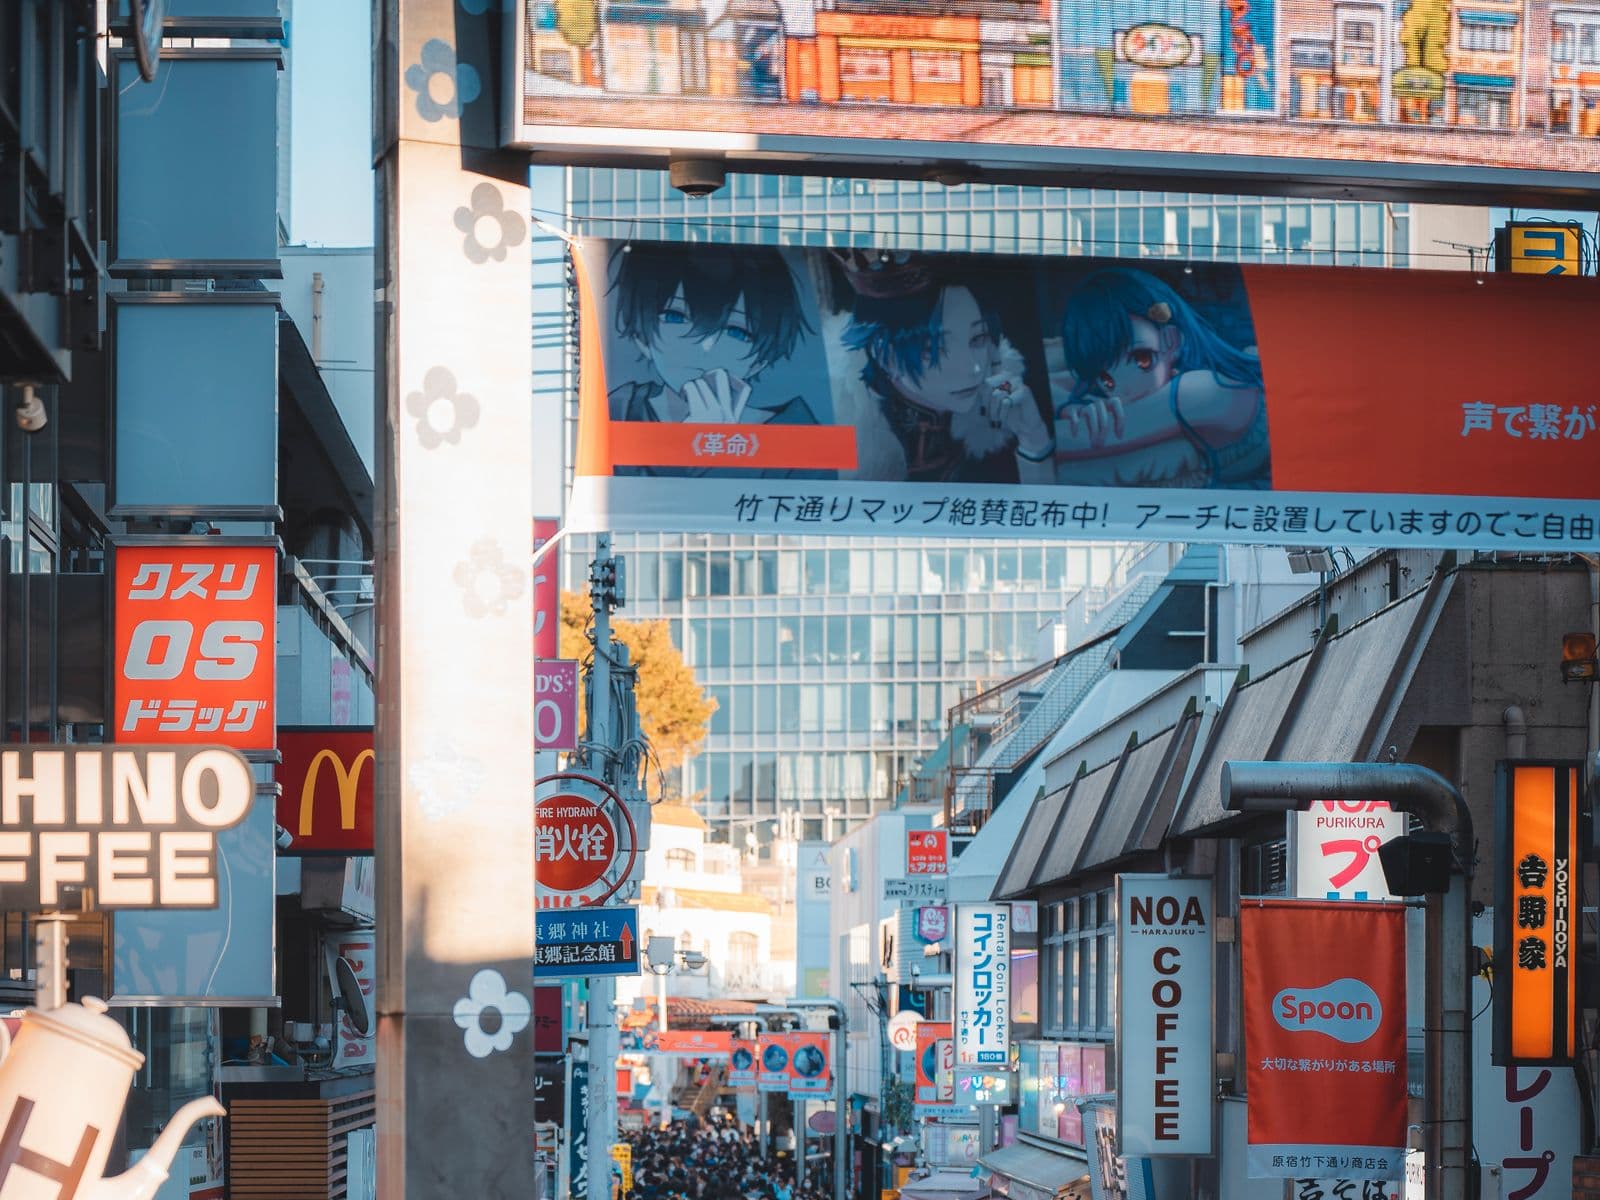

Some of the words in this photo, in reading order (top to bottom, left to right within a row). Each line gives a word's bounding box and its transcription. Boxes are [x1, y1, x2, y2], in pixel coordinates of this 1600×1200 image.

[1135, 503, 1600, 541] アーチに設置していますのでご自由
[128, 563, 261, 601] クスリ
[123, 620, 264, 681] OS
[122, 699, 267, 733] ドラッグ
[1, 749, 251, 827] HINO
[556, 806, 598, 818] HYDRANT
[1316, 817, 1385, 828] PURIKURA
[1130, 896, 1206, 926] NOA
[1518, 853, 1548, 970] 吉野家
[996, 913, 1006, 957] Rental
[973, 913, 992, 1045] コインロッカー
[996, 962, 1006, 993] Coin
[996, 1000, 1006, 1045] Locker
[1281, 995, 1373, 1024] Spoon
[1152, 946, 1182, 1141] COFFEE
[1261, 1057, 1396, 1074] 大切な繋がりがある場所
[1272, 1155, 1389, 1170] 原宿竹下通り商店会
